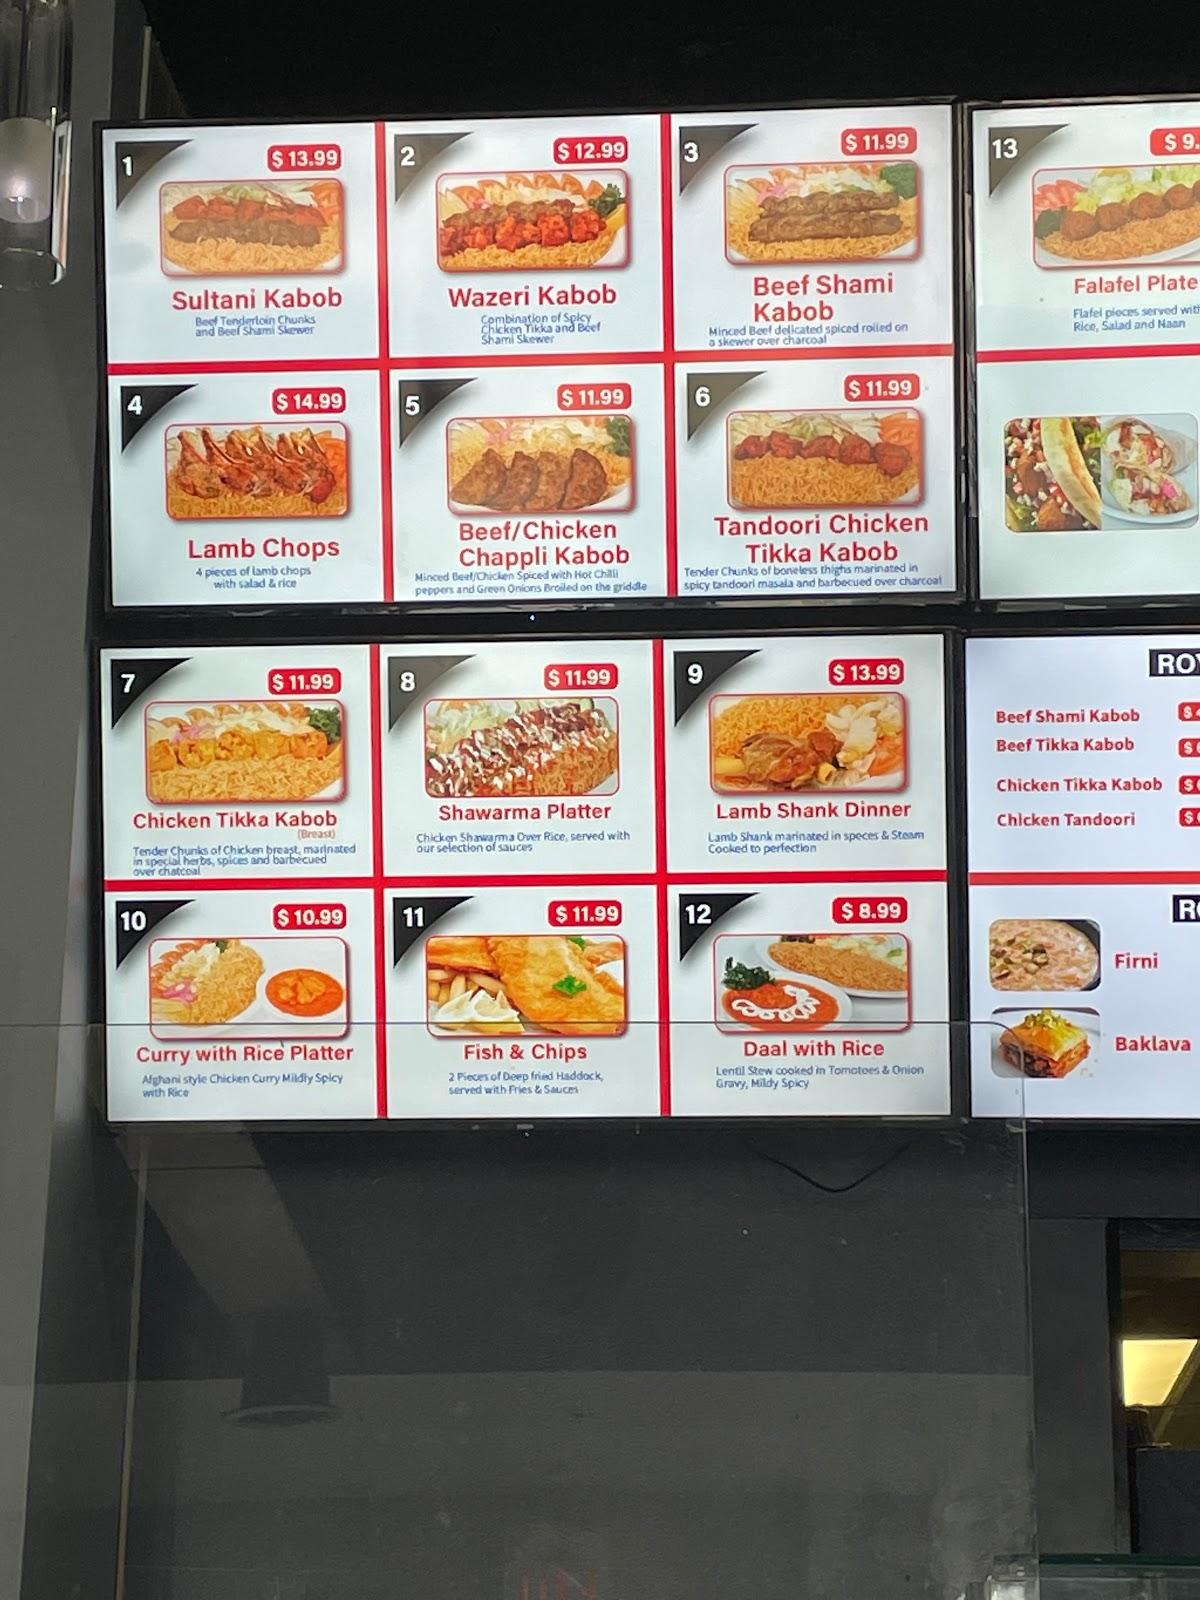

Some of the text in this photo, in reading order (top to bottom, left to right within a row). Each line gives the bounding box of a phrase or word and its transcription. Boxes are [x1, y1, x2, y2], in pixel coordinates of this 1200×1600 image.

[575, 142, 624, 158] 12.99
[863, 134, 908, 150] 11.99
[992, 138, 1018, 159] 13
[289, 151, 337, 166] 13.99
[400, 147, 415, 166] 2
[684, 142, 698, 162] 3
[122, 156, 133, 176] 1
[754, 273, 892, 296] Beef Shami
[1074, 274, 1199, 293] Falafel Plate
[172, 287, 341, 310] Sultani Kabob
[448, 284, 616, 307] Wazeri Kabob
[754, 300, 833, 322] Kabob
[195, 315, 315, 326] Beef Tenderloin Chunks
[1102, 320, 1131, 330] Salad
[1134, 320, 1154, 329] and
[1157, 319, 1185, 328] Naan
[195, 325, 314, 336] and Beef Shami Skewer
[481, 334, 554, 344] Shami Skewer
[718, 336, 754, 346] skewer
[757, 337, 779, 345] over
[782, 335, 826, 344] charcoal
[866, 380, 911, 396] 11.99
[127, 395, 142, 415] 4
[293, 393, 342, 409] 14.99
[579, 390, 623, 405] 11.99
[695, 387, 711, 407] 6
[405, 396, 419, 415] 5
[460, 521, 616, 540] Beef/Chicken
[714, 513, 927, 535] Tandoori Chicken
[188, 538, 339, 561] Lamb Chops
[459, 545, 629, 569] Chappli Kabob
[745, 541, 897, 563] Tikka Kabob
[195, 566, 310, 577] 4 pieces of lamb chops
[415, 572, 449, 581] Minced
[452, 571, 514, 581] Beef/Chicken
[517, 570, 549, 580] Spiced
[550, 570, 572, 579] with
[574, 570, 591, 579] Hot
[684, 563, 918, 576] Tender Chunks of boneless thighs marinated in
[213, 579, 236, 588] with
[238, 578, 265, 588] salad
[278, 578, 296, 587] rice
[565, 670, 610, 685] 11.99
[688, 664, 703, 684] 9
[850, 664, 900, 680] 13.99
[121, 674, 135, 693] 7
[289, 674, 333, 690] 11.99
[400, 672, 415, 691] 8
[996, 708, 1139, 723] Beef Shami Kabob
[996, 737, 1133, 752] Beef Tikka Kabob
[996, 777, 1162, 792] Chicken Tikka Kabob
[439, 803, 611, 820] Shawarma Platter
[717, 800, 910, 819] Lamb Shank Dinner
[133, 810, 336, 828] Chicken Tikka Kabob
[997, 812, 1134, 826] Chicken Tandoori
[297, 829, 335, 839] (Breast)
[436, 843, 483, 852] selection
[485, 843, 495, 851] of
[708, 842, 816, 854] Cooked to perfection
[133, 867, 155, 876] over
[294, 909, 342, 925] 10.99
[403, 907, 424, 927] 11
[573, 905, 618, 922] 11.99
[685, 904, 712, 924] 12
[859, 902, 900, 918] 8.99
[1179, 900, 1200, 920] R
[120, 911, 146, 931] 10
[1115, 952, 1157, 968] Firni
[744, 1040, 884, 1056] Daal with Rice
[1116, 1035, 1190, 1052] Baklava
[136, 1045, 353, 1065] Curry with Rice Platter
[464, 1044, 502, 1059] Fish
[532, 1043, 586, 1062] Chips
[449, 1085, 482, 1094] served
[484, 1084, 506, 1094] with
[508, 1084, 532, 1093] Fries
[544, 1084, 578, 1094] Sauces
[781, 1077, 808, 1088] Spicy
[142, 1088, 188, 1097] with Rice
